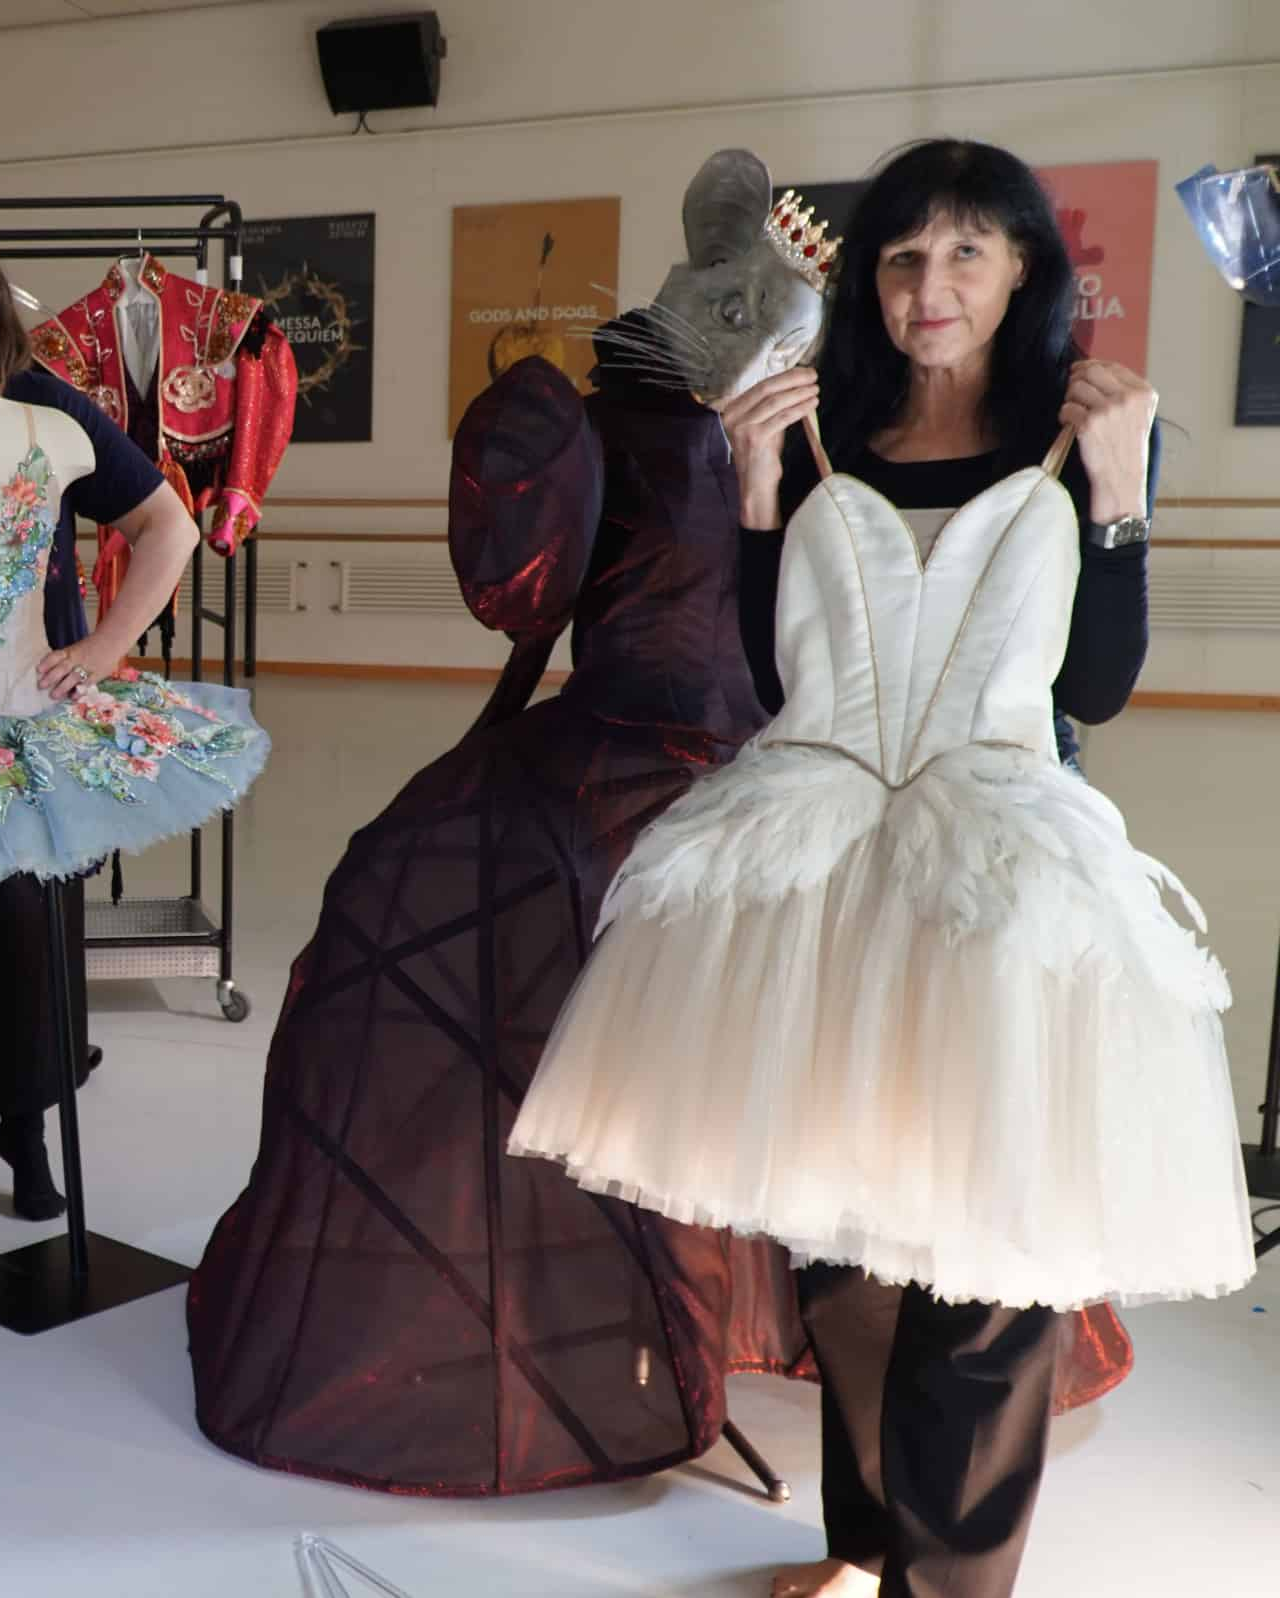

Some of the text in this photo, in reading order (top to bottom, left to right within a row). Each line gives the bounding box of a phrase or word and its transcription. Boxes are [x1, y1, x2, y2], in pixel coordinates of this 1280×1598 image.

[470, 309, 513, 323] GODS
[514, 307, 549, 321] AND
[287, 327, 344, 343] EQUIEM
